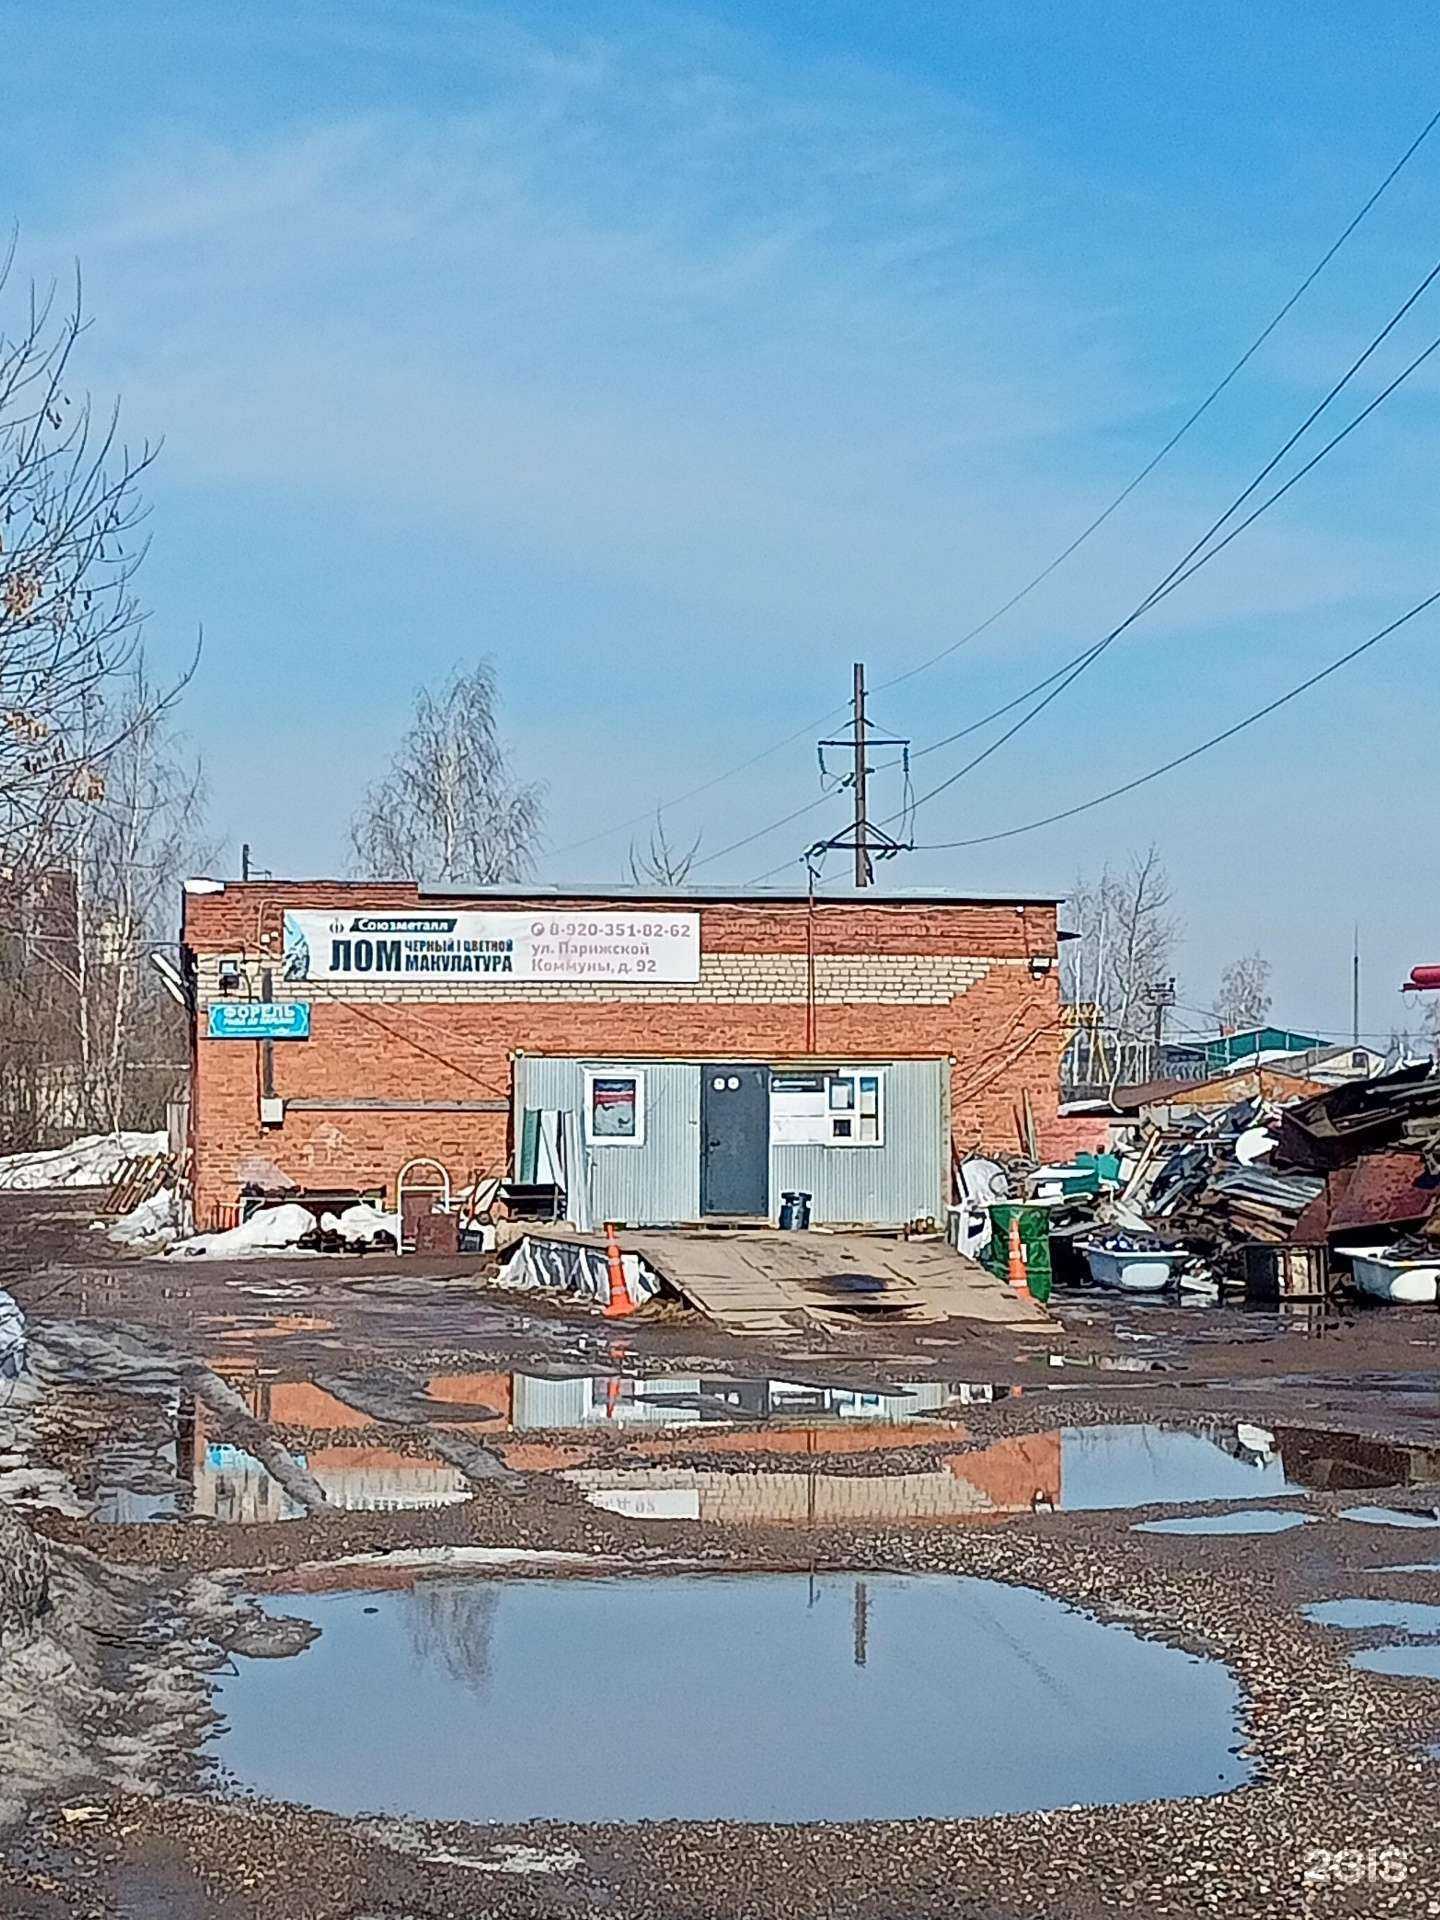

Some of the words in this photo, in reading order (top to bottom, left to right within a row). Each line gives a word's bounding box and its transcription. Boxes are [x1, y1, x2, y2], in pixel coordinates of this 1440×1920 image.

[358, 918, 449, 931] Союзметалл
[550, 923, 691, 938] 8-920-351-82-62
[463, 938, 513, 952] ЦВЕТНОЙ
[531, 943, 555, 956] ул.
[559, 941, 650, 957] Парижской
[329, 939, 402, 972] ЛОМ
[404, 954, 513, 972] МАКУЛАТУРА
[531, 958, 615, 974] Коммуны,
[618, 962, 632, 974] д.
[636, 960, 657, 972] 92
[223, 1004, 296, 1018] ФОРЕЛЬ
